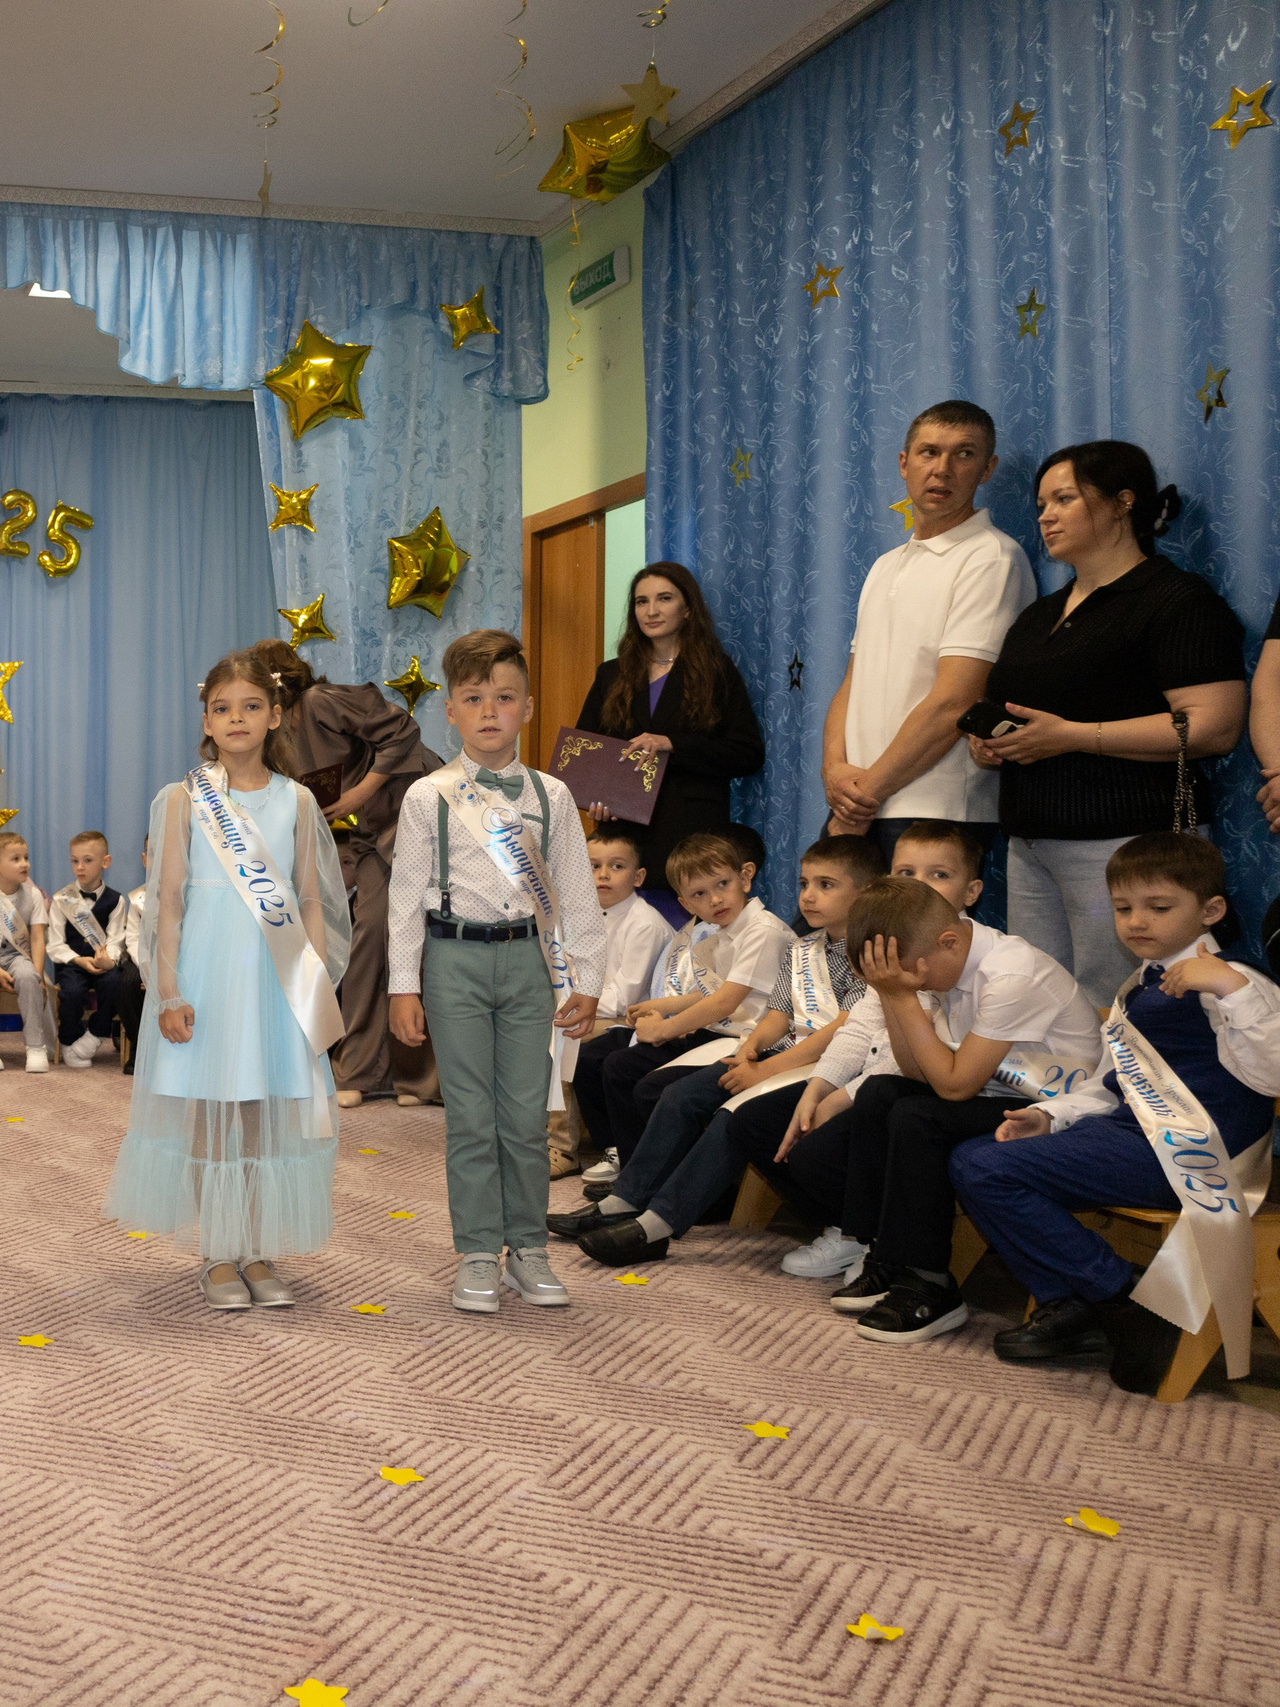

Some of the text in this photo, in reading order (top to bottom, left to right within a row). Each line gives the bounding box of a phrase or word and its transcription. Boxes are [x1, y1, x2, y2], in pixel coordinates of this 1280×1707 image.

[573, 262, 613, 295] ВЫХОД
[235, 860, 294, 927] 2025
[480, 807, 554, 918] Выпускник
[1106, 1022, 1241, 1214] Выпускник 2025
[1161, 1082, 1195, 1115] Ярослав
